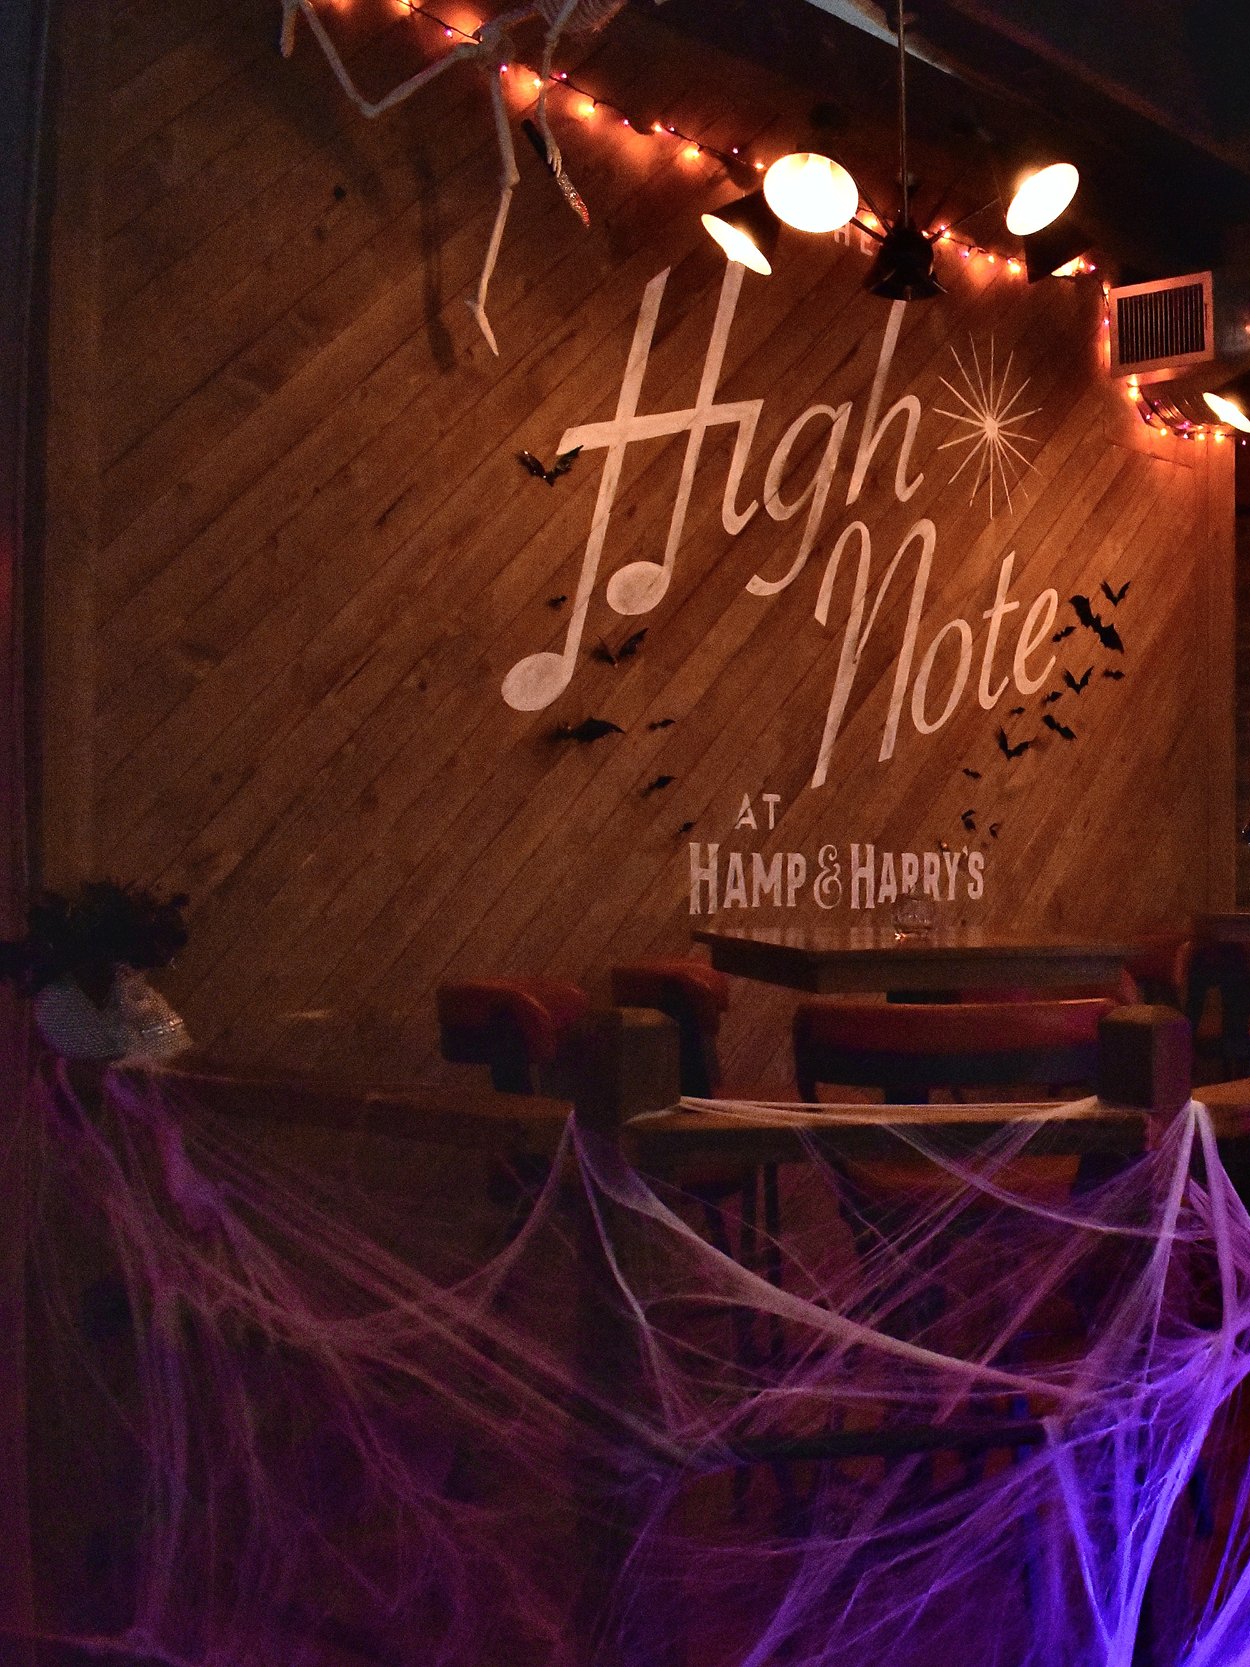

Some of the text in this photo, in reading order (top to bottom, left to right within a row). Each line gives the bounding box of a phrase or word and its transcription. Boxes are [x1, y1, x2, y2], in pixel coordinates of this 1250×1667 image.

[501, 261, 924, 711] High
[812, 518, 1059, 789] Note
[688, 842, 807, 915] HAMP
[813, 844, 843, 910] &
[734, 793, 781, 830] AT
